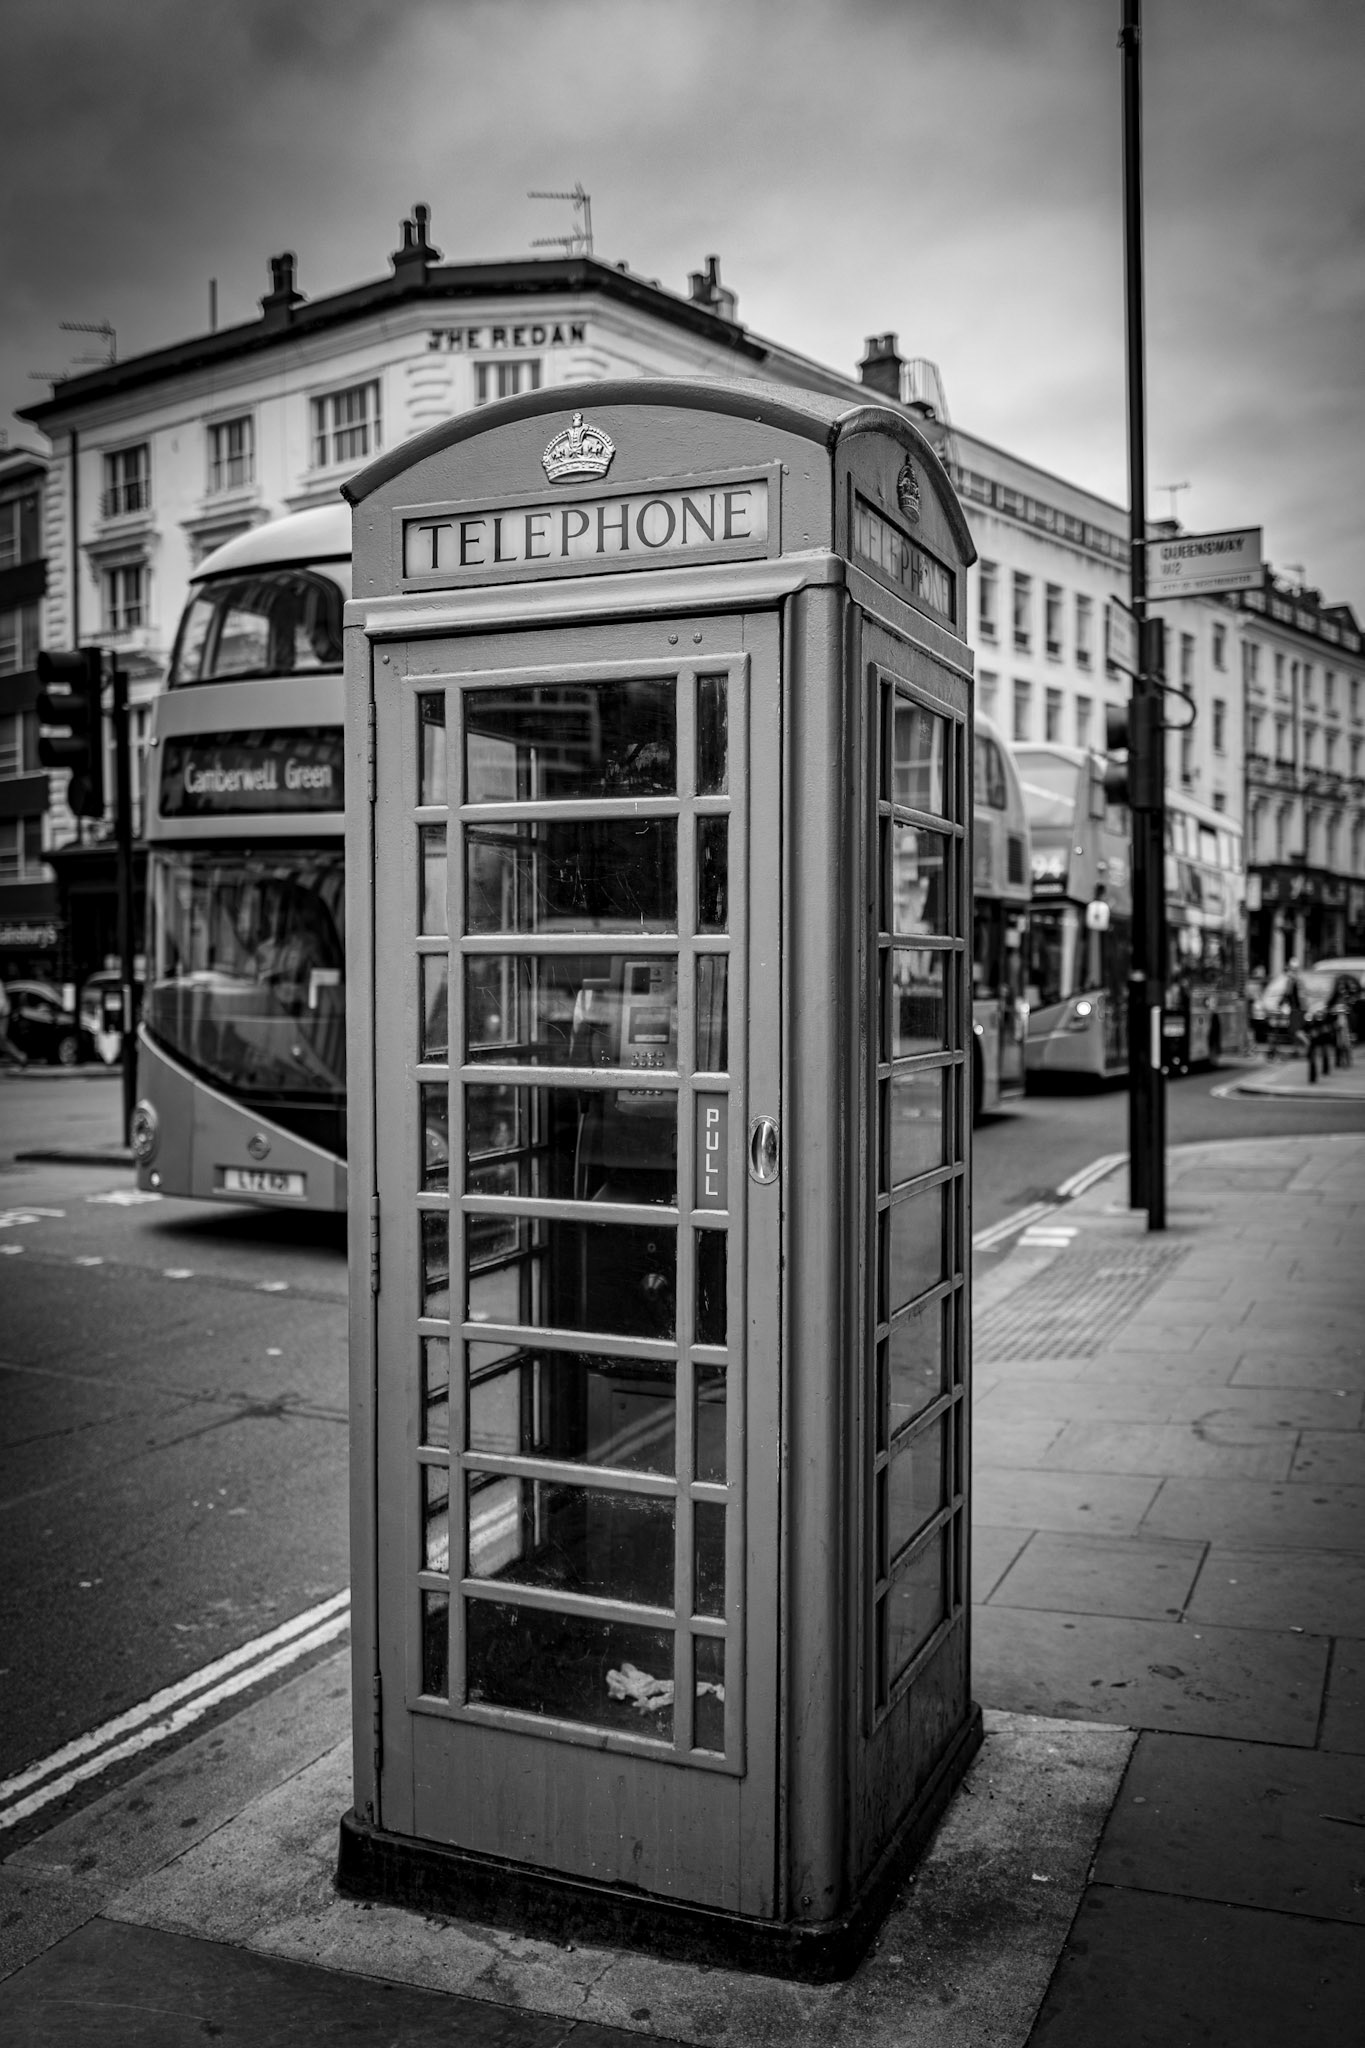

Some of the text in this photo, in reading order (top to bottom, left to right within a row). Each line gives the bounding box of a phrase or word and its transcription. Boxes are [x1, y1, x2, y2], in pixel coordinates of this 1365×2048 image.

[493, 322, 585, 348] REDAN
[418, 489, 752, 569] TELEPHONE
[1162, 538, 1245, 560] QUEENSWAY
[184, 757, 332, 793] Camberwell Green
[1031, 853, 1064, 880] 94
[705, 1108, 719, 1196] PULL
